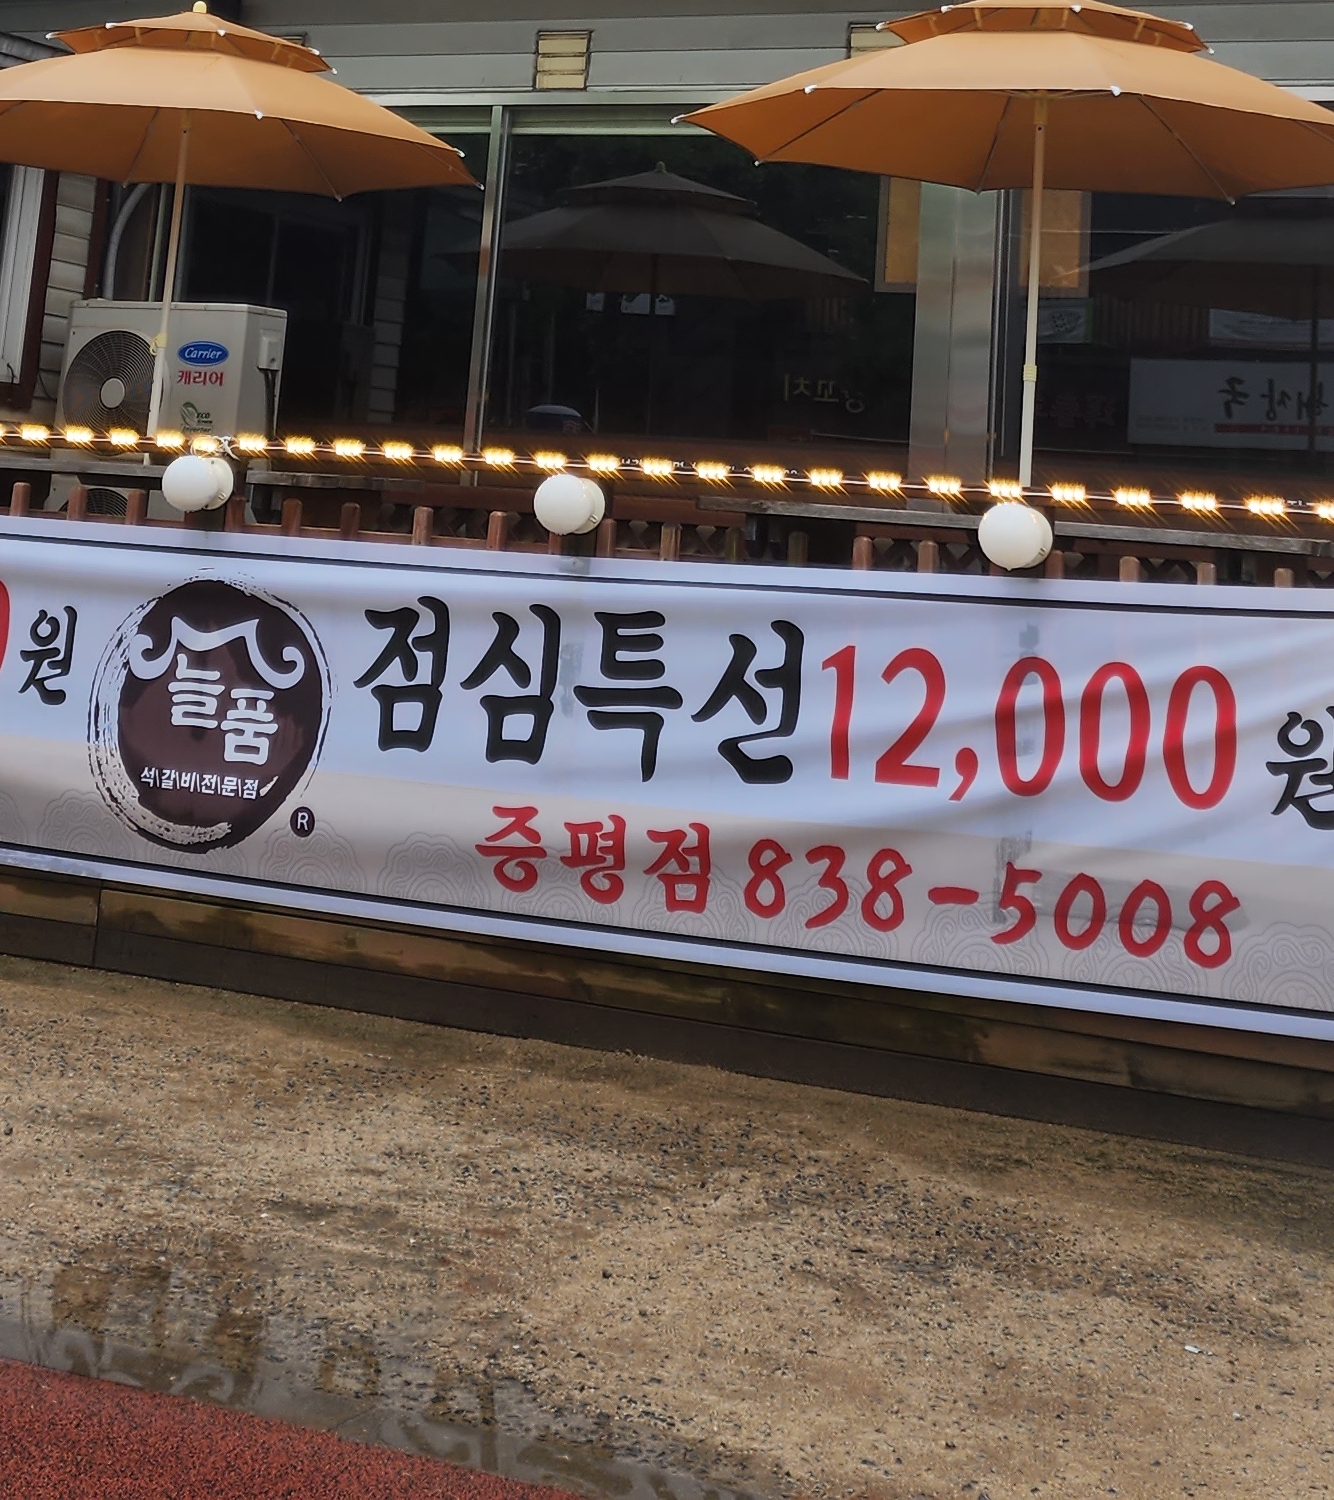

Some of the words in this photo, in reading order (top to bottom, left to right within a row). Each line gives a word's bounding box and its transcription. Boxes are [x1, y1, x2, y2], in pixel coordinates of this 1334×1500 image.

[177, 370, 225, 387] 캐리어
[185, 347, 222, 359] Carrier
[167, 653, 279, 765] 늘품
[475, 805, 712, 916] 증평점
[742, 837, 1242, 970] 838-5008
